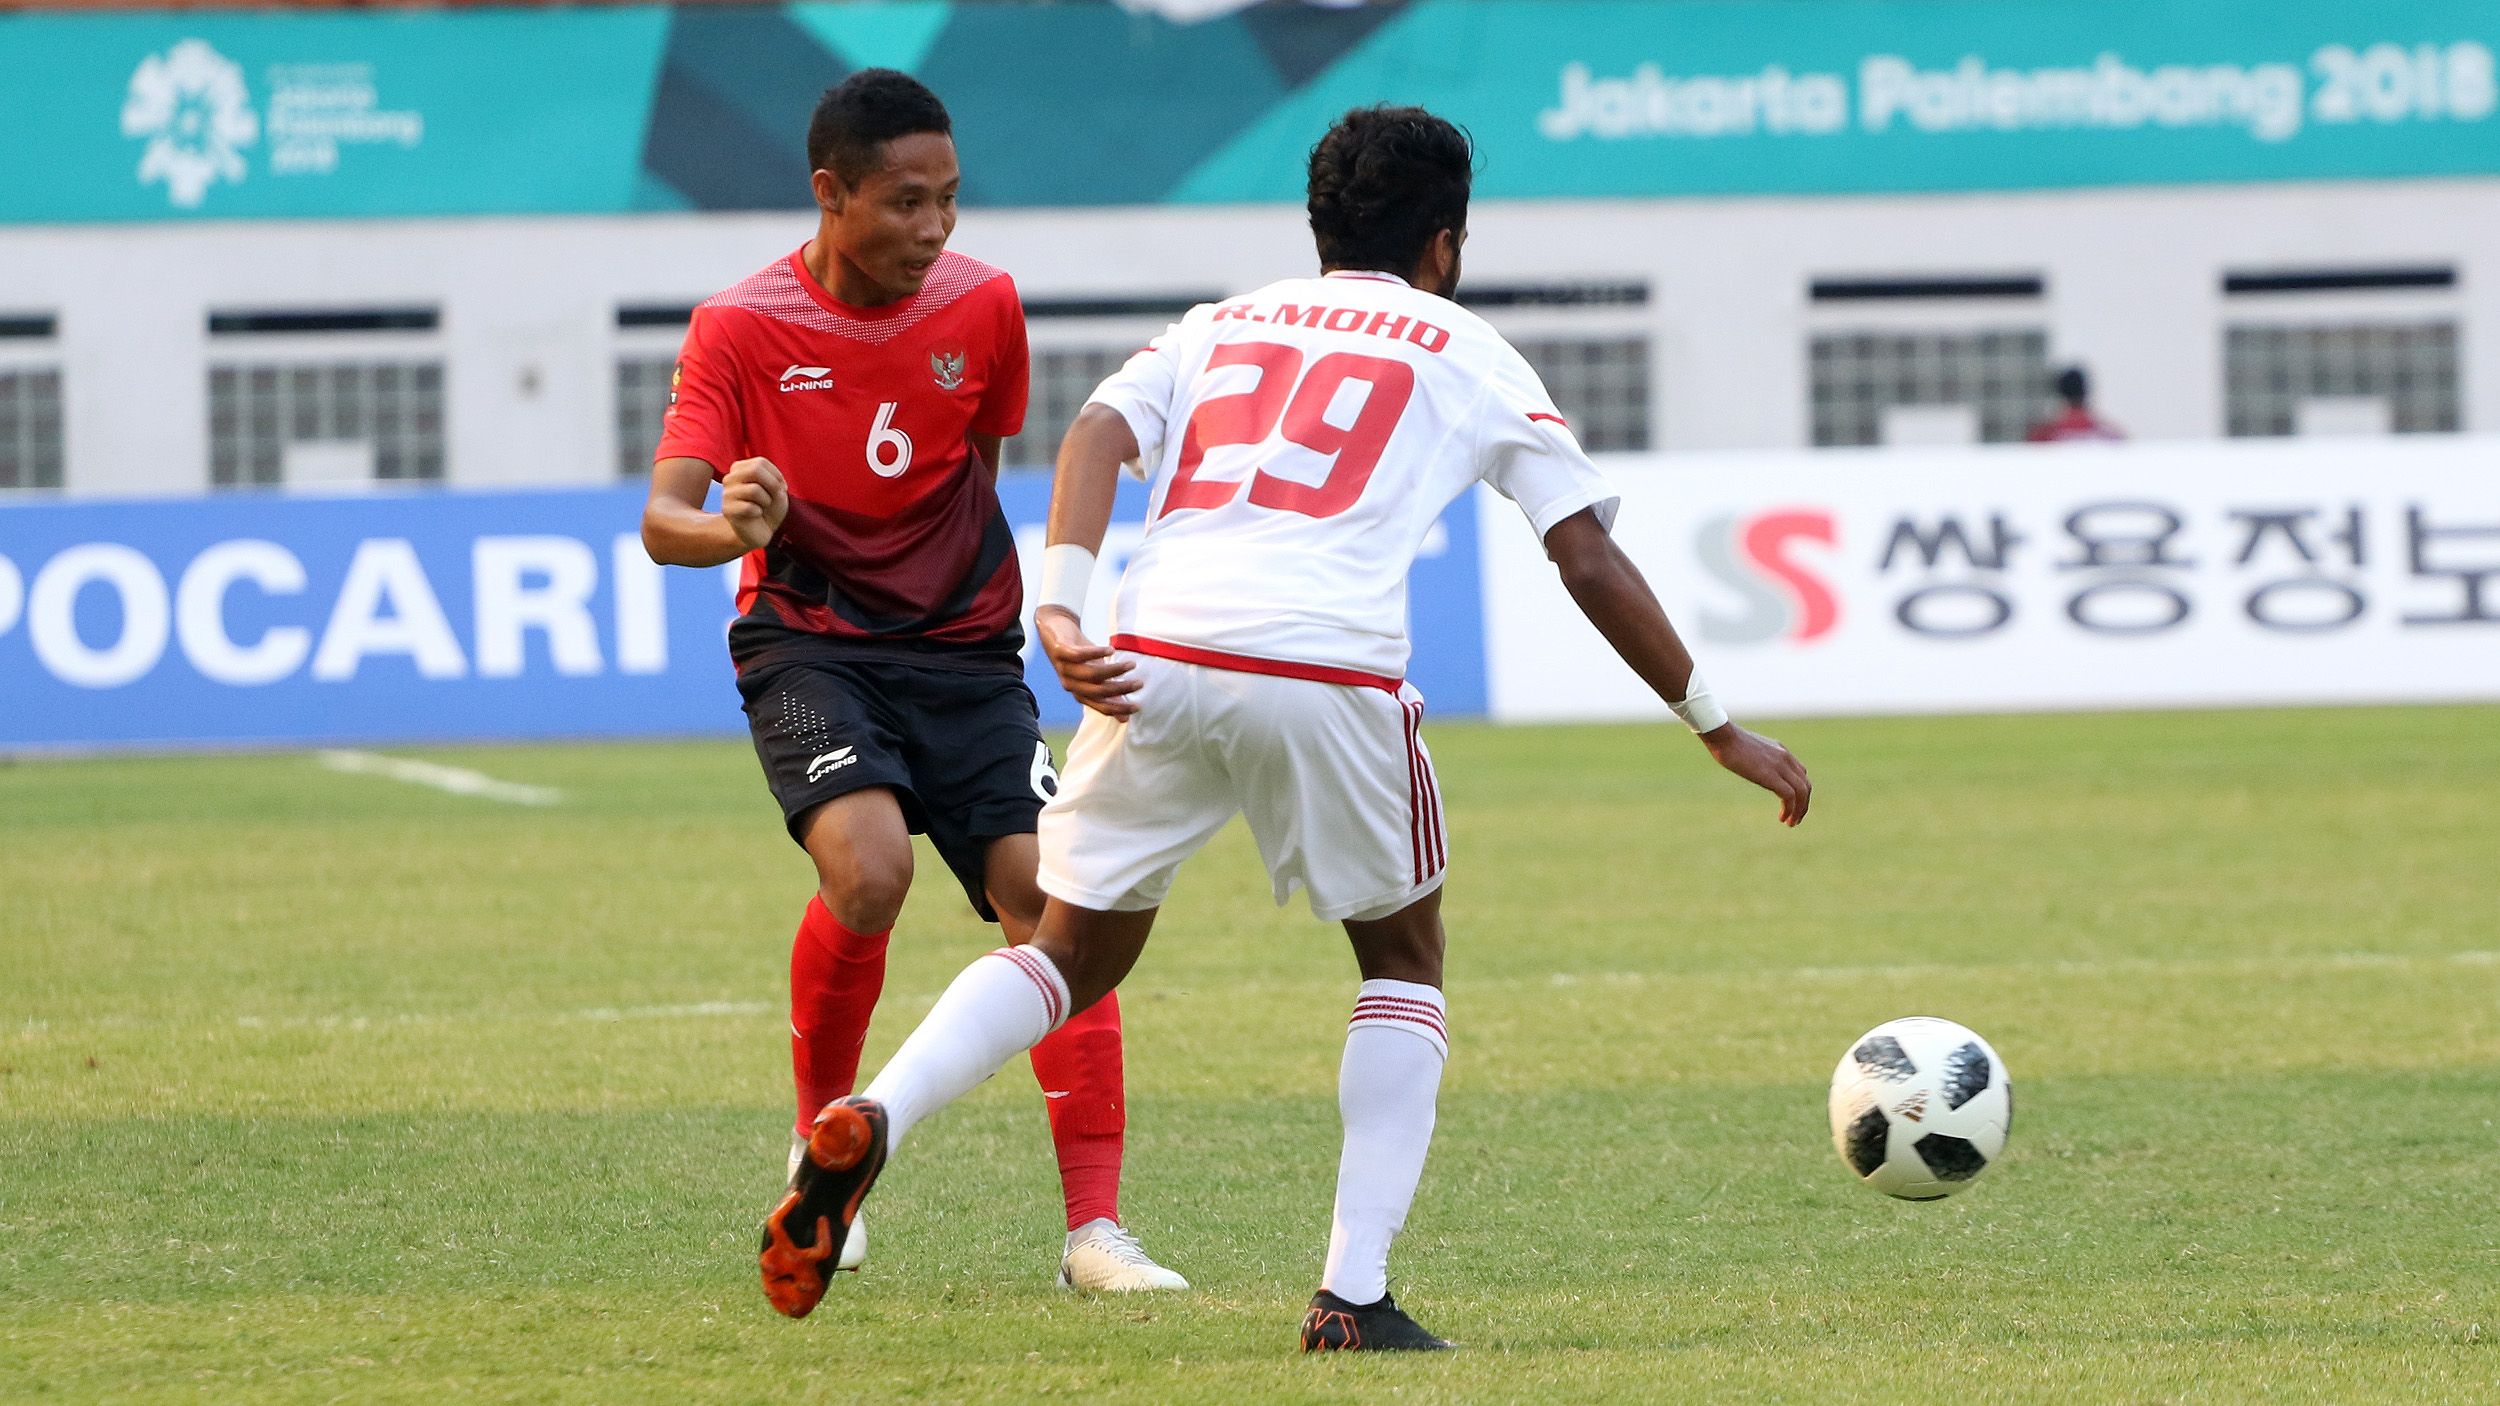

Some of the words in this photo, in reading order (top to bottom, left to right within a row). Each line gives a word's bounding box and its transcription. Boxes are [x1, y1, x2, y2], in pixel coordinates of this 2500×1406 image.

[1540, 61, 1846, 140] Jakarta
[1858, 52, 2304, 142] Palembang
[2309, 42, 2497, 125] 2018
[1212, 303, 1450, 353] R.MOHD
[780, 379, 834, 392] LI-NING
[866, 402, 913, 479] 6
[1157, 341, 1415, 519] 29
[0, 533, 670, 688] OCARI
[809, 754, 858, 783] LI-NING
